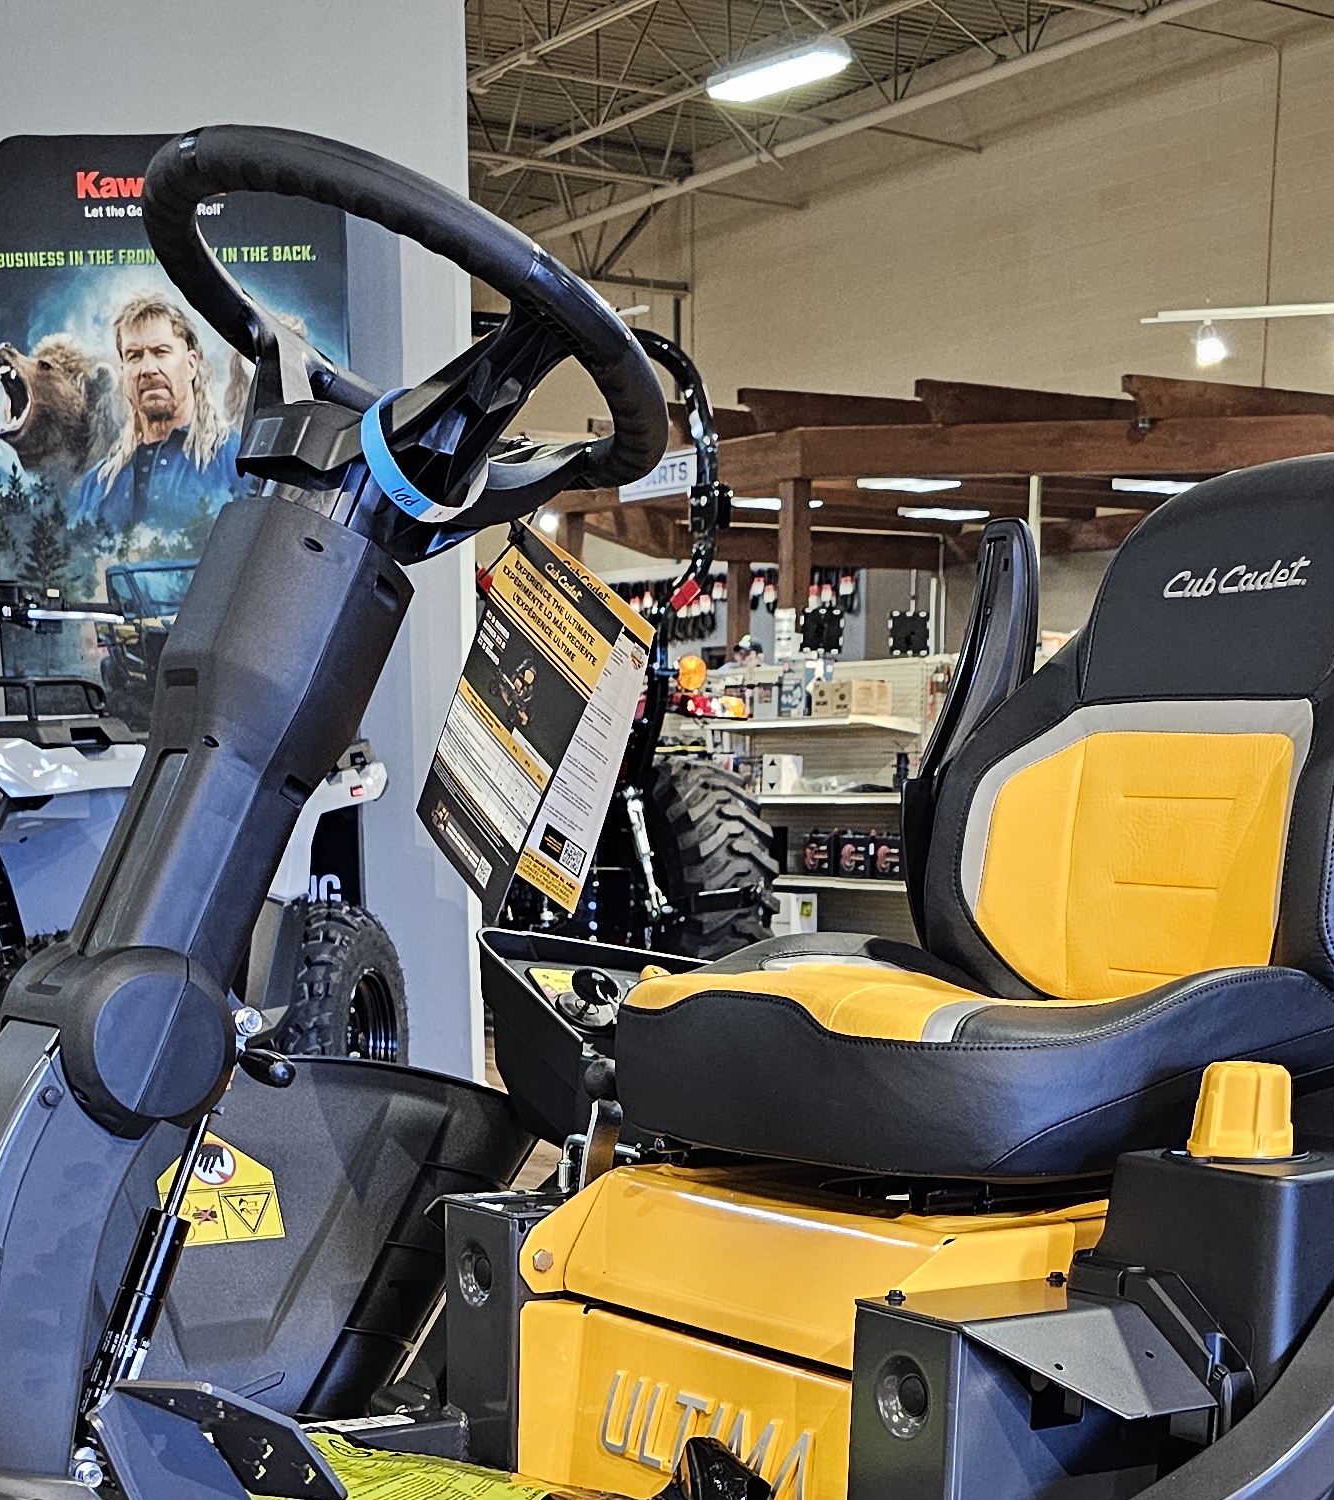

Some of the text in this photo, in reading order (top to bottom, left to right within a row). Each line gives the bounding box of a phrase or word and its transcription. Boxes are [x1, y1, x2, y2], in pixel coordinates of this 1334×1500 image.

[85, 206, 103, 218] Let
[106, 205, 125, 218] the
[69, 250, 83, 266] IN
[88, 250, 114, 265] THE
[119, 248, 156, 265] FRON
[223, 247, 237, 263] IN
[241, 246, 269, 262] THE
[636, 461, 687, 489] ARTS
[557, 576, 585, 604] Cadet
[1163, 556, 1311, 598] Cub Cadet
[503, 564, 597, 666] EXPERIMENTE LO MÁS RECIENTE
[515, 560, 596, 646] EXPERIENCE THE ULTIMATE
[553, 634, 577, 662] ULTIME
